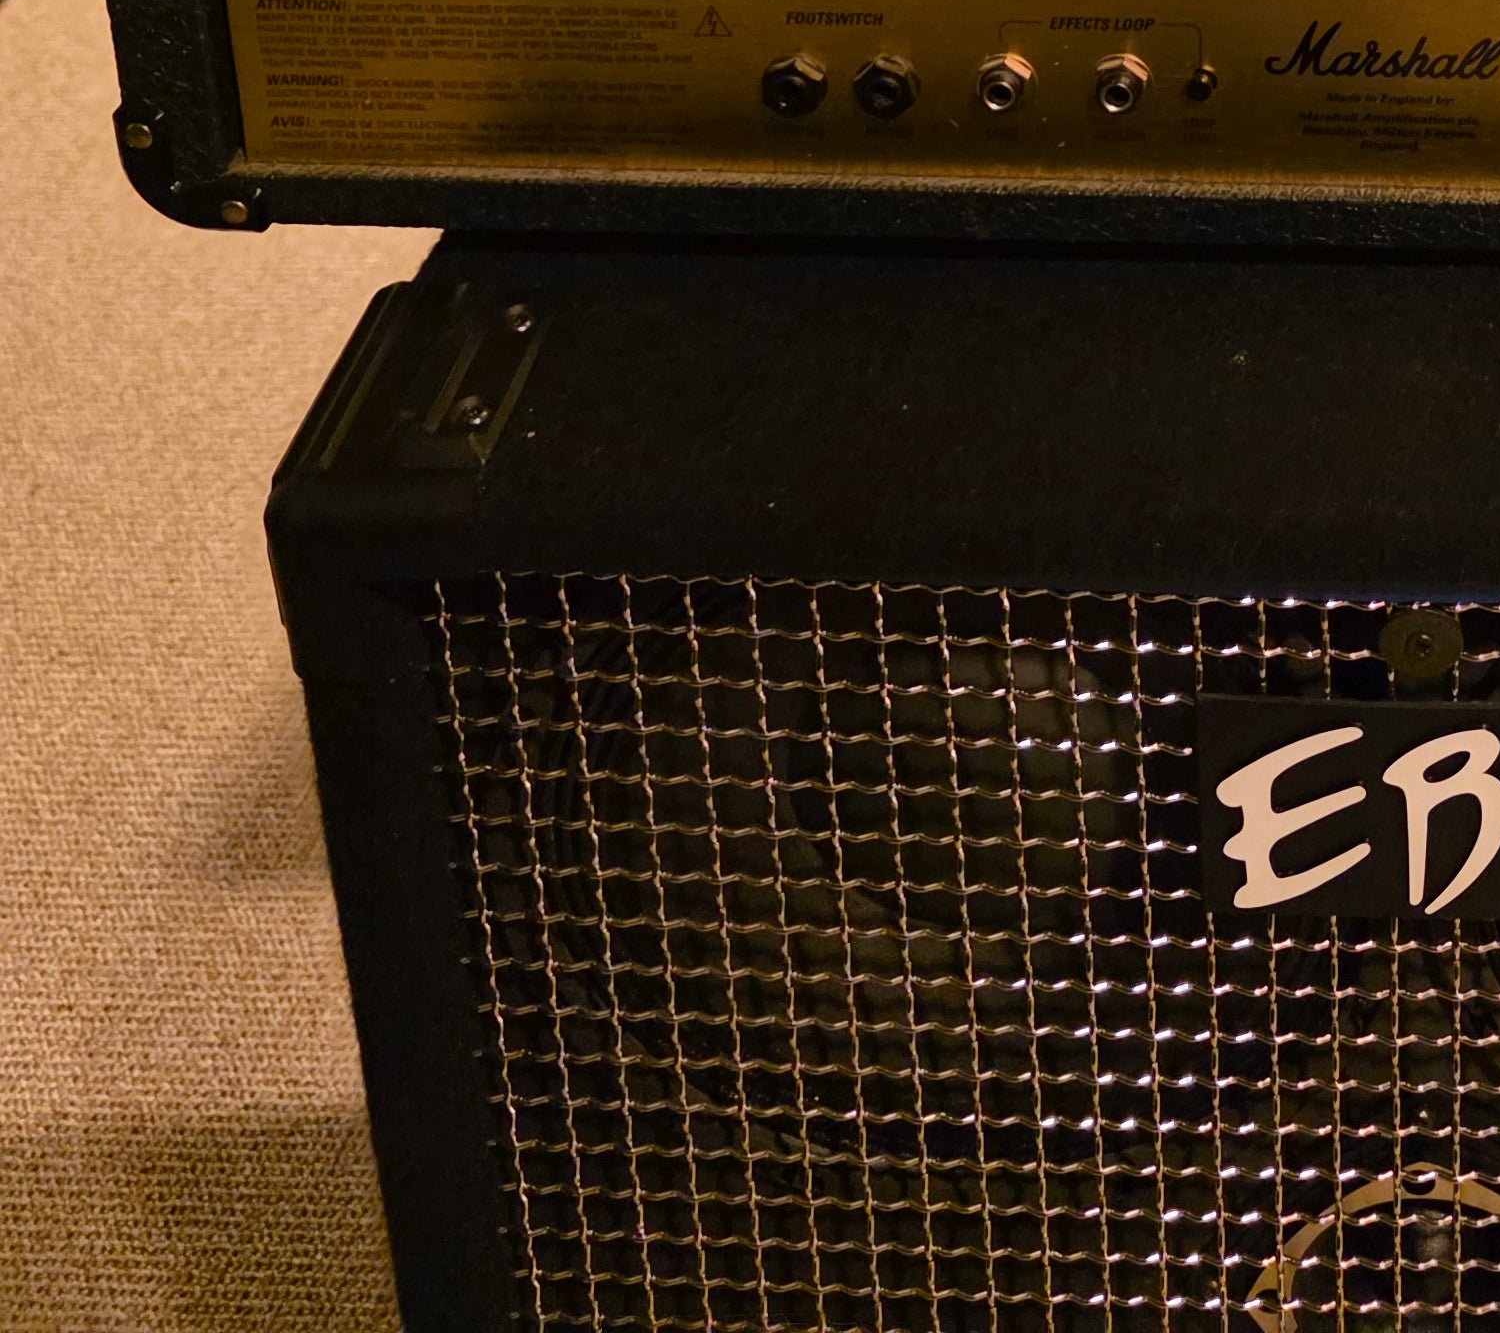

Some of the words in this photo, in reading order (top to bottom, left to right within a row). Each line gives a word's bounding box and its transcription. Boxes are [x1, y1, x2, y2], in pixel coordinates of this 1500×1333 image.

[786, 12, 883, 26] FOOTSWITCH
[1050, 17, 1110, 31] EFFECTS
[1114, 18, 1156, 32] LOOP
[1326, 92, 1361, 103] Made
[1365, 93, 1378, 103] in
[1380, 93, 1433, 106] England
[1300, 112, 1359, 123] Marshall
[1361, 112, 1455, 125] Amplification
